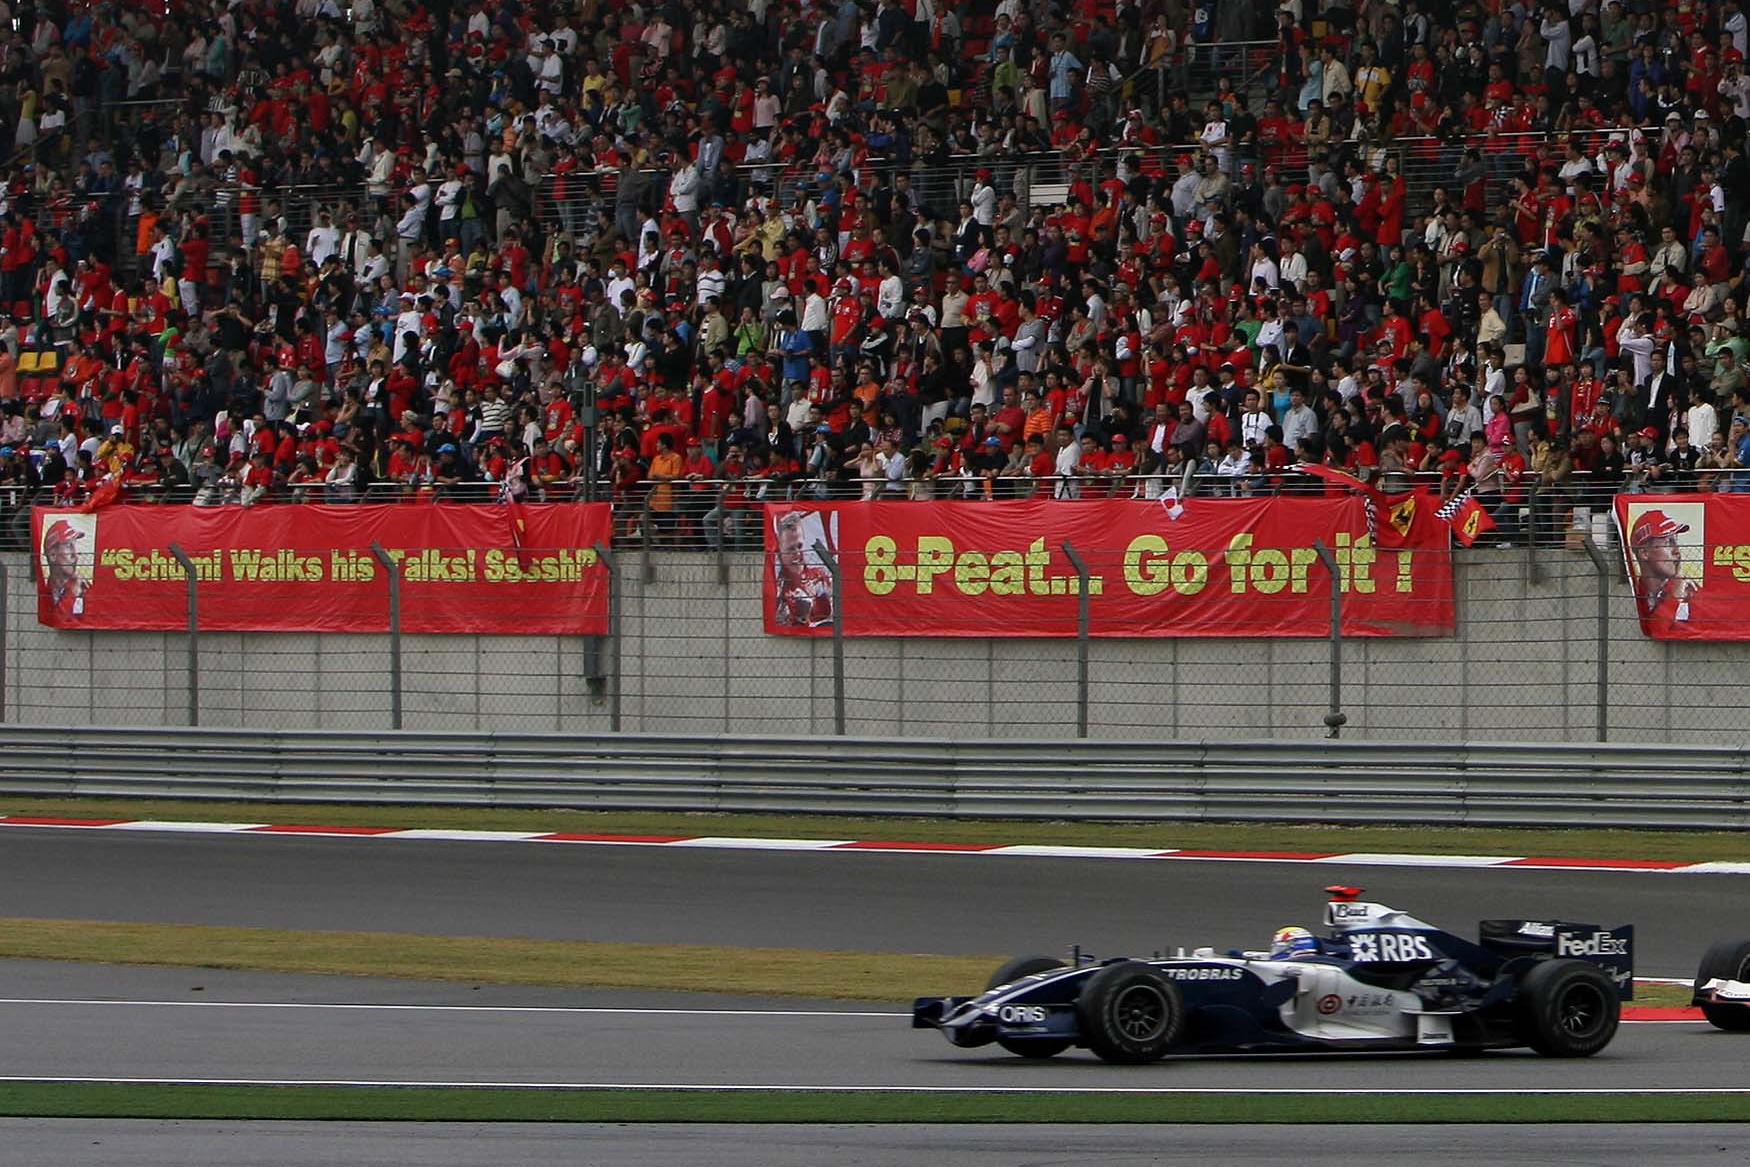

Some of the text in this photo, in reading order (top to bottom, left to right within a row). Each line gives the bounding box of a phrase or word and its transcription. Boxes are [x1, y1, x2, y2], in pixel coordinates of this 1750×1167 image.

[230, 549, 322, 581] Walks
[331, 549, 375, 581] his
[1123, 535, 1208, 595] Go
[1225, 533, 1318, 594] for
[1336, 533, 1376, 593] it
[1380, 934, 1433, 962] RBS
[1559, 932, 1628, 956] FedEx
[1000, 1005, 1046, 1023] ORIS
